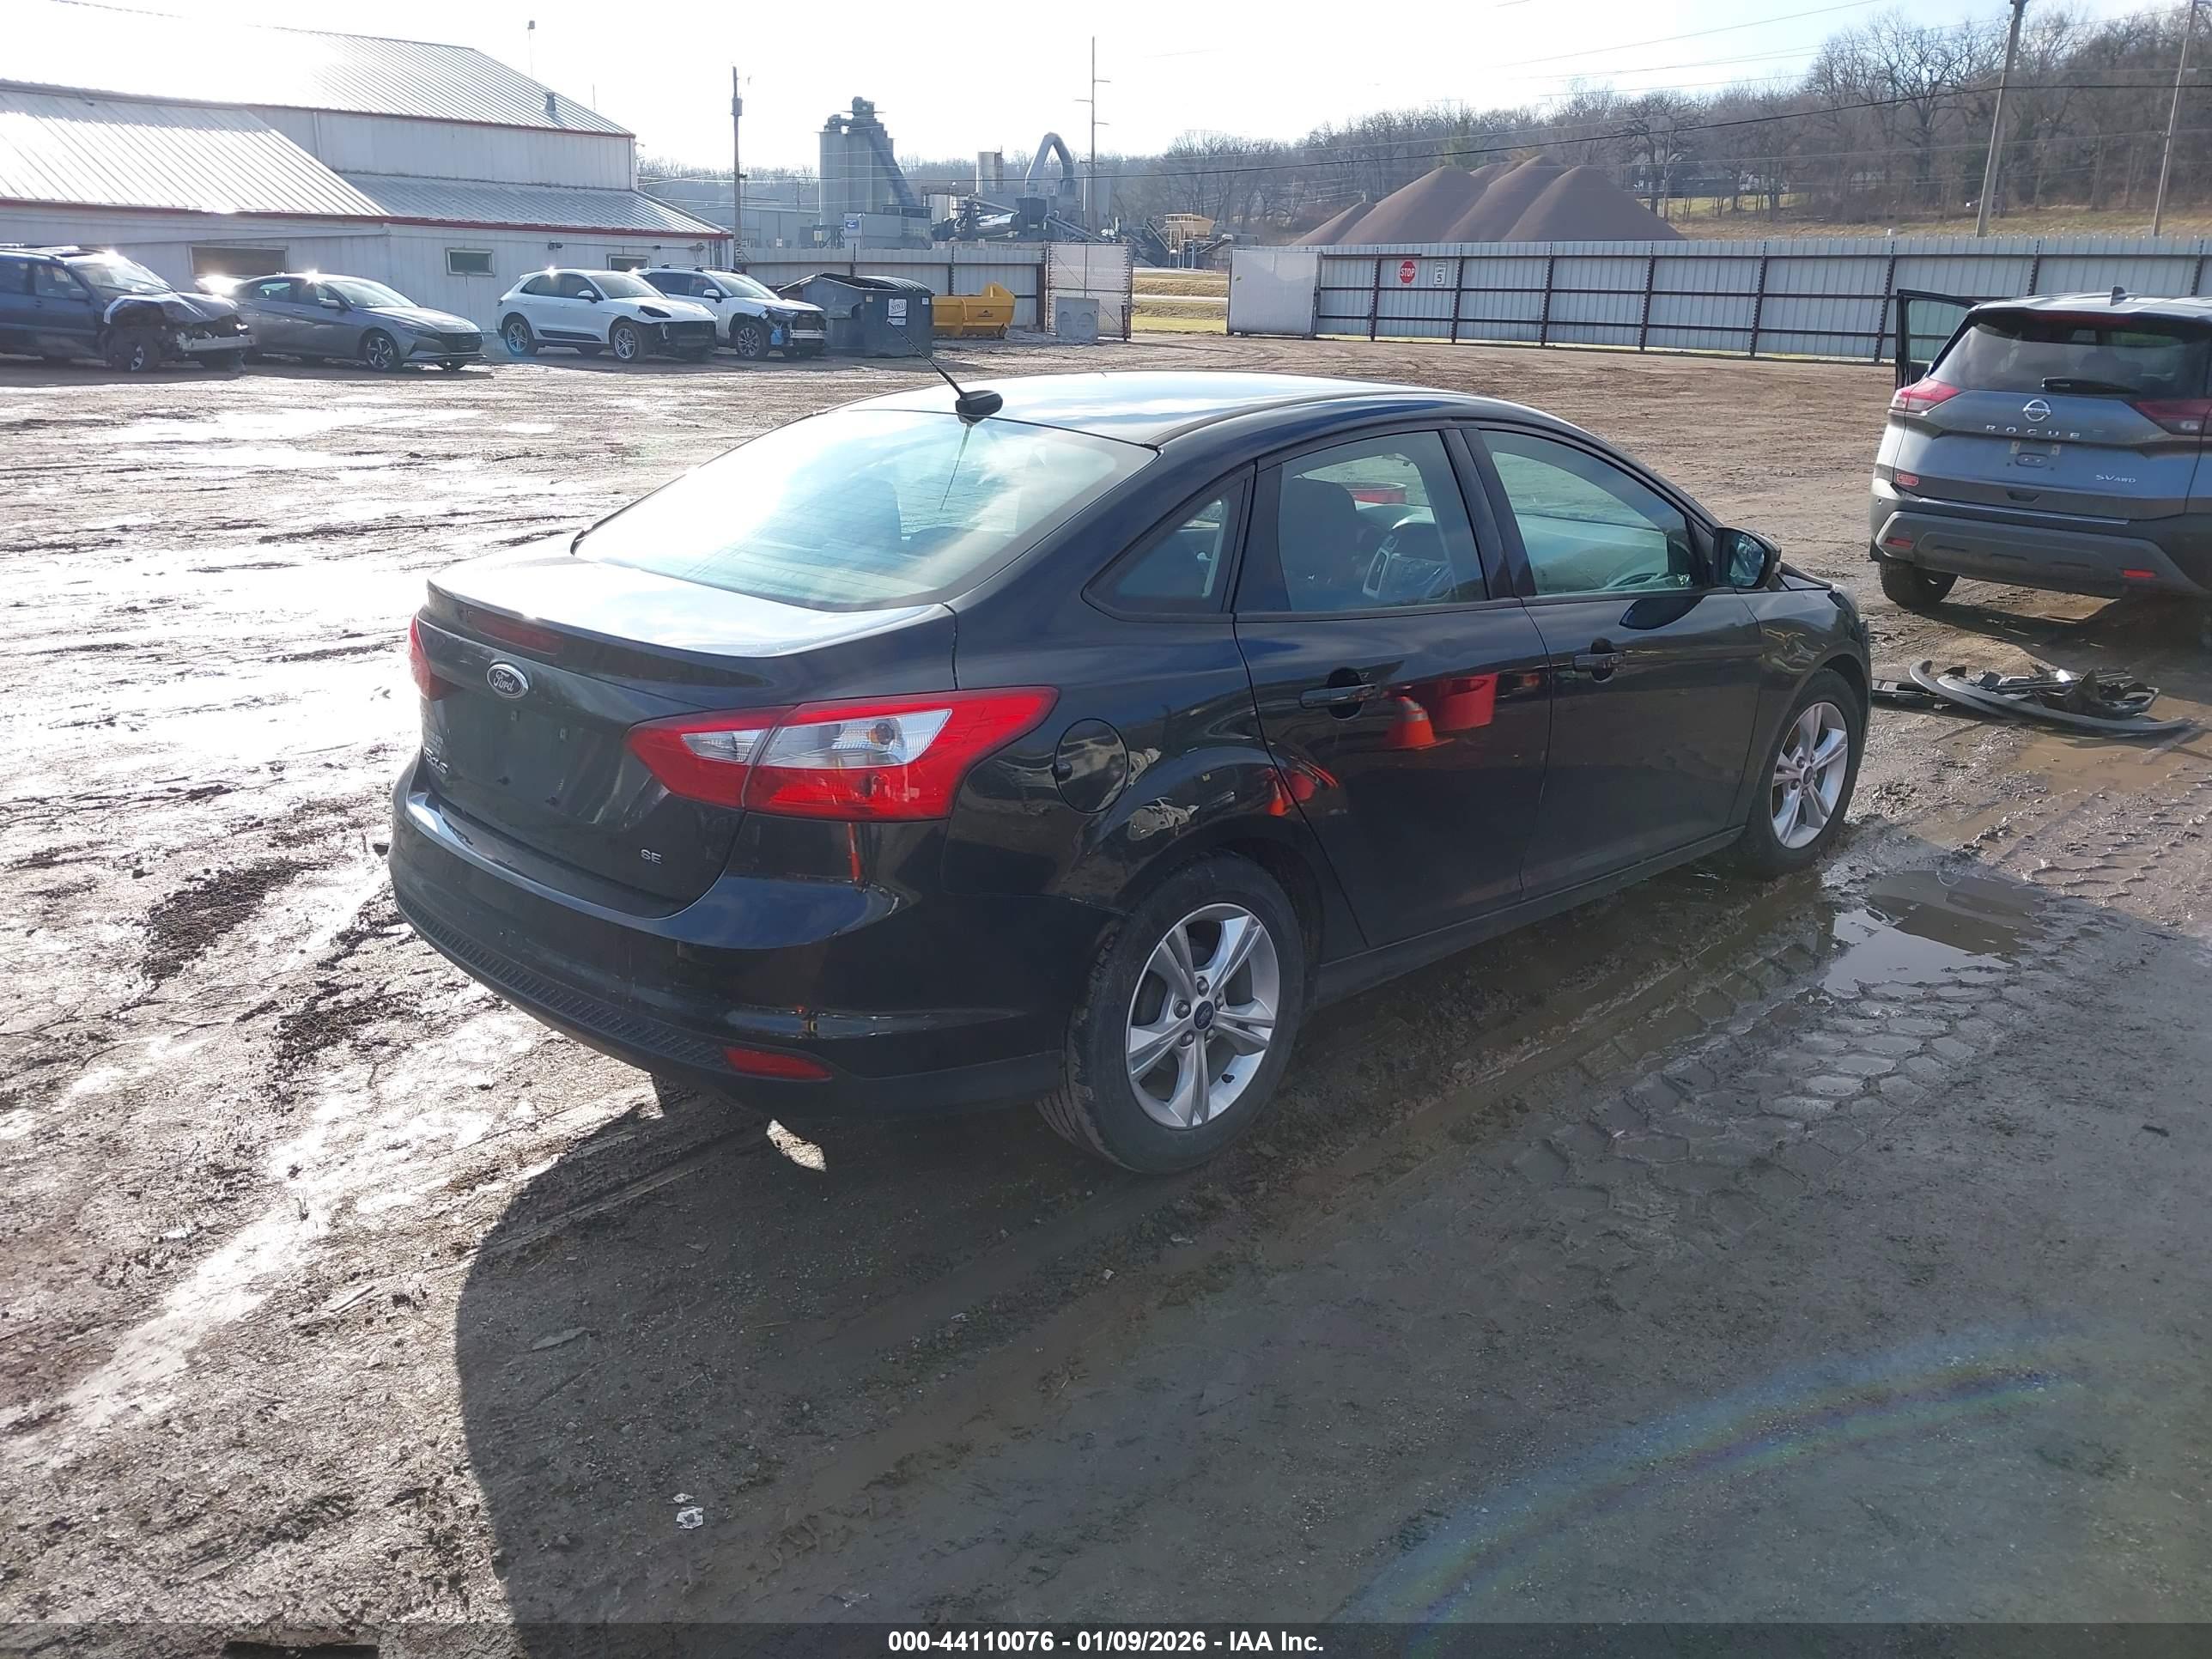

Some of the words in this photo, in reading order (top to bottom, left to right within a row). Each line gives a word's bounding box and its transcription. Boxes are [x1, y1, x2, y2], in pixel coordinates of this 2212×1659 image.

[1401, 267, 1415, 277] STOP
[1437, 274, 1443, 283] 5
[1985, 424, 2081, 439] ROGUE
[493, 670, 515, 692] Ford
[641, 848, 662, 865] SE
